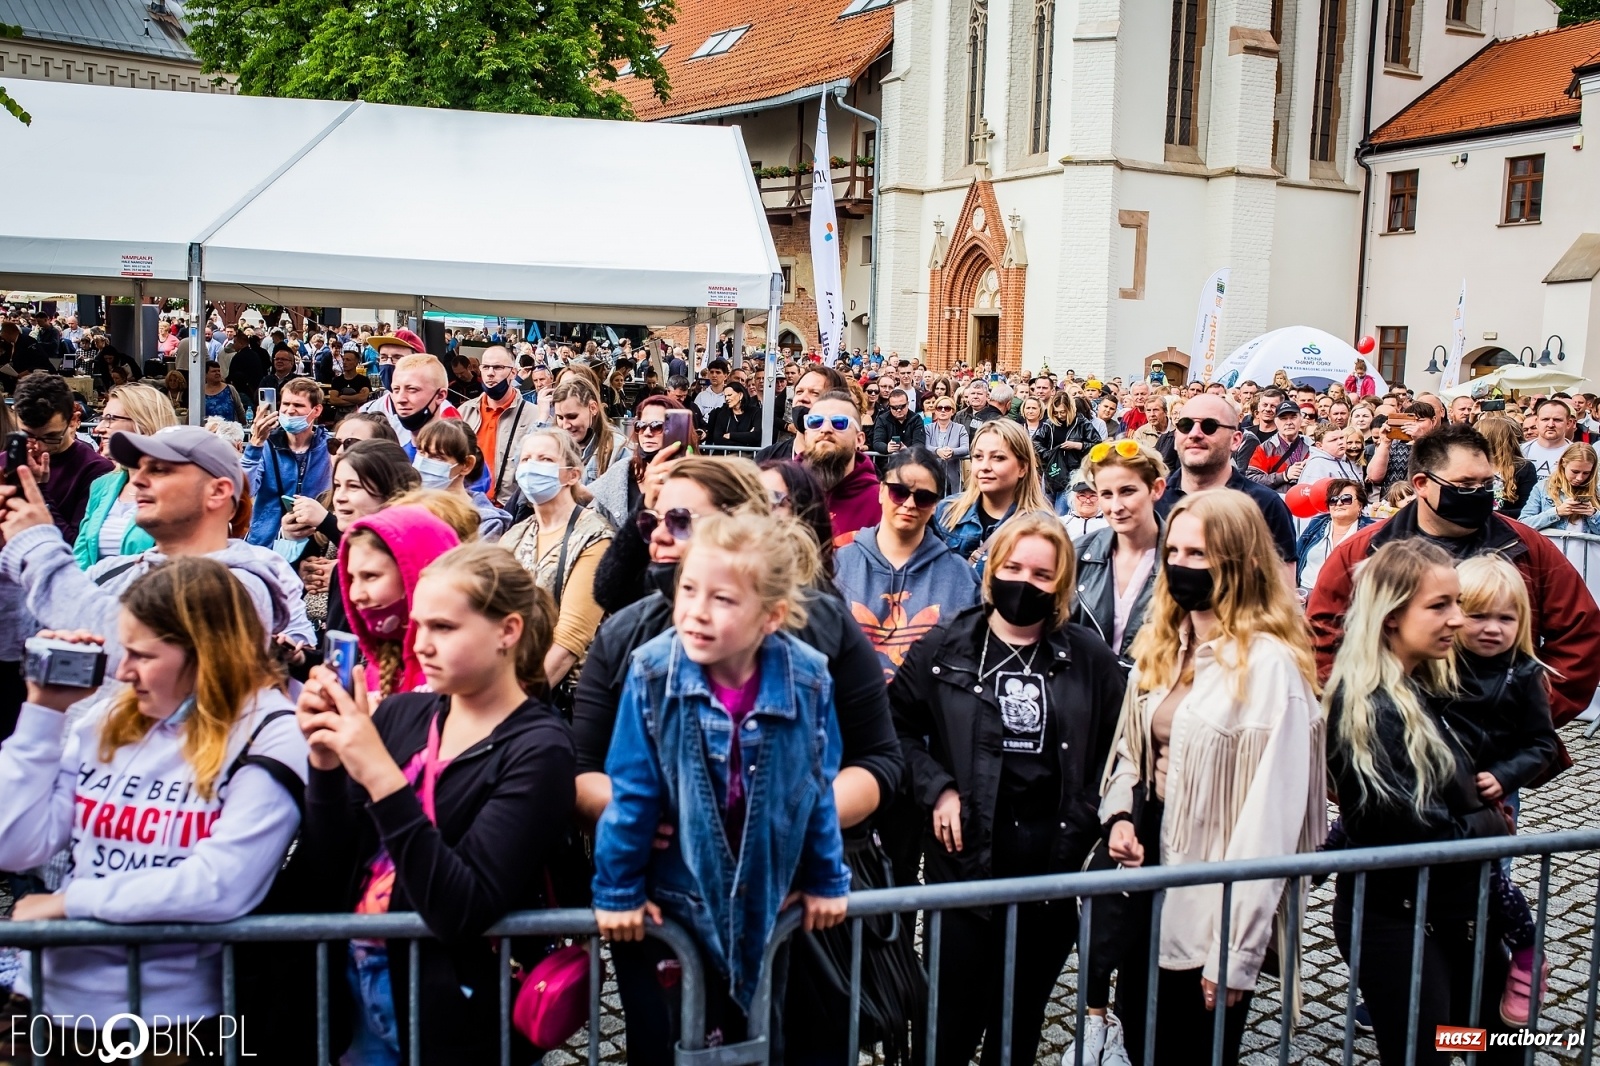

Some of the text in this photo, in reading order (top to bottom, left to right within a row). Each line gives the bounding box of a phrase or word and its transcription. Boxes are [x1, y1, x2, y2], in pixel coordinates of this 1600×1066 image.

[1205, 314, 1218, 361] Smaki
[78, 763, 141, 798] HAE
[75, 795, 222, 848] TRACTIV
